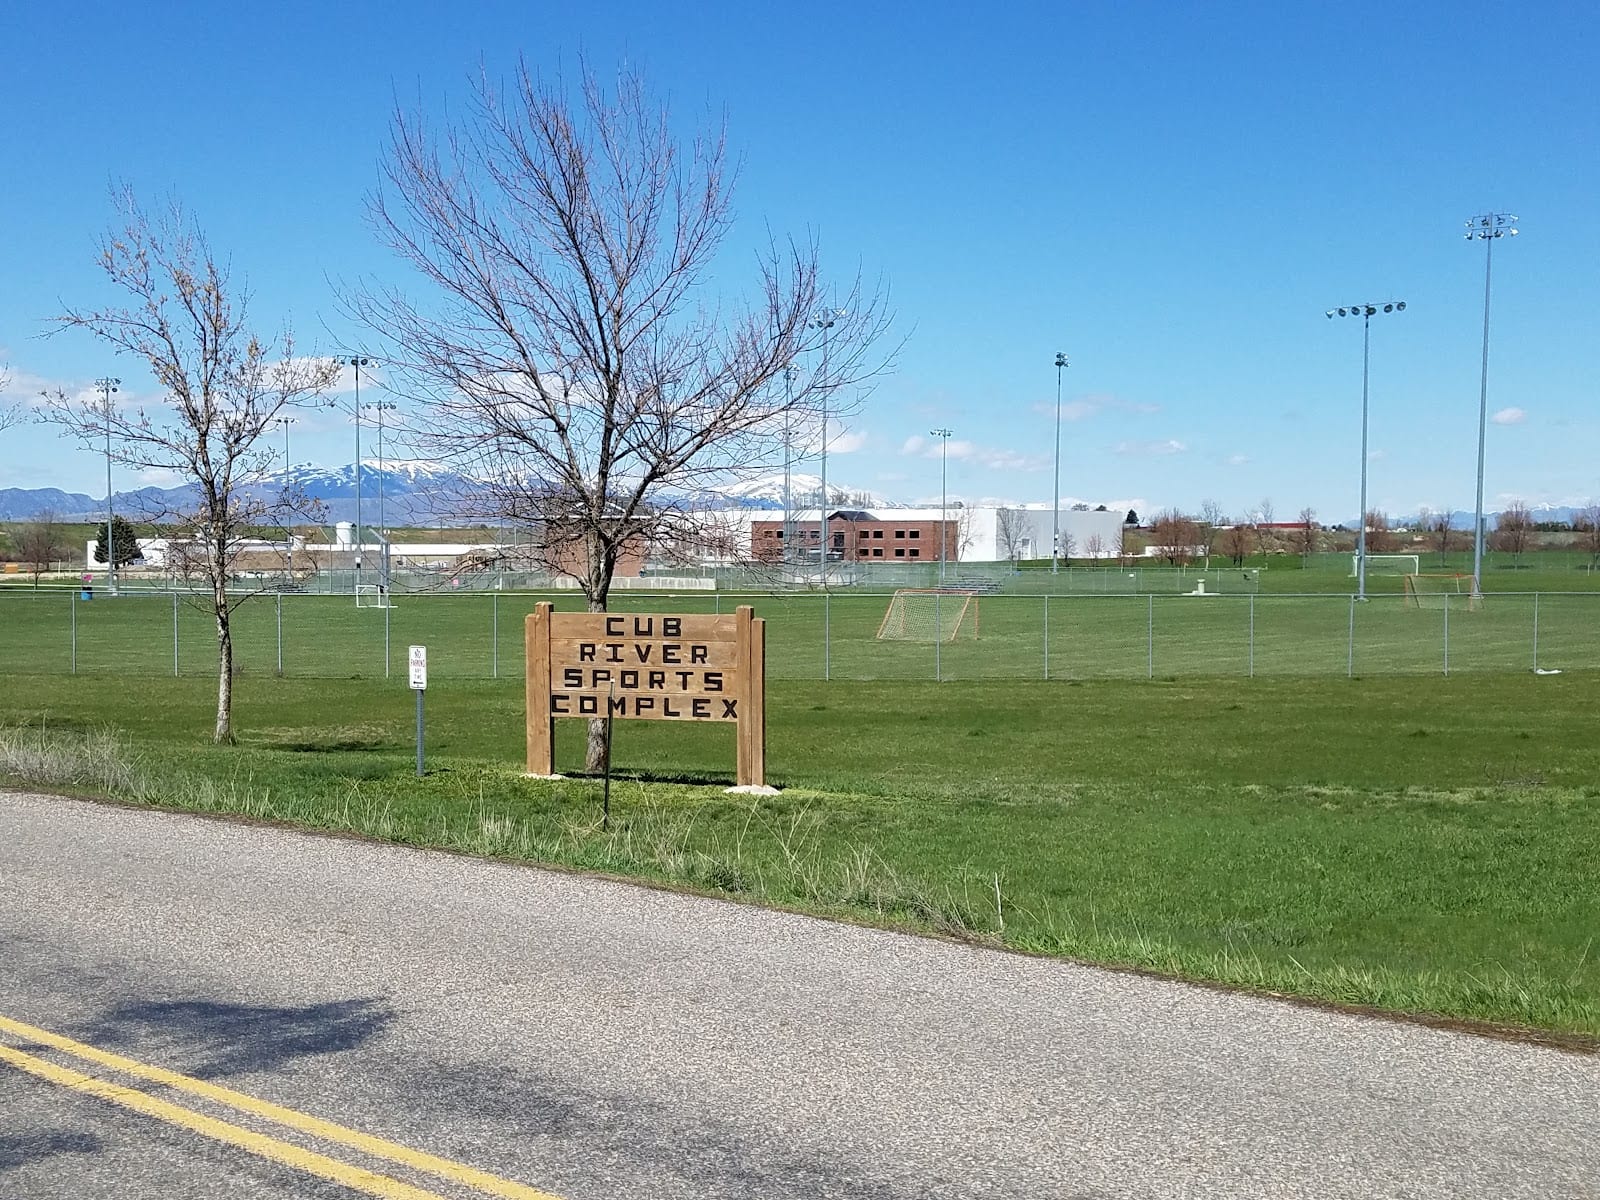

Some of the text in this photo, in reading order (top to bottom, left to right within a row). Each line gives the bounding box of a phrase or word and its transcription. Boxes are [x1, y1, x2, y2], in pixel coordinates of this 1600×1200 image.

[606, 617, 681, 636] CUB
[580, 643, 708, 664] RIVER
[564, 668, 723, 692] SPORTS
[551, 694, 738, 719] COMPLEX
